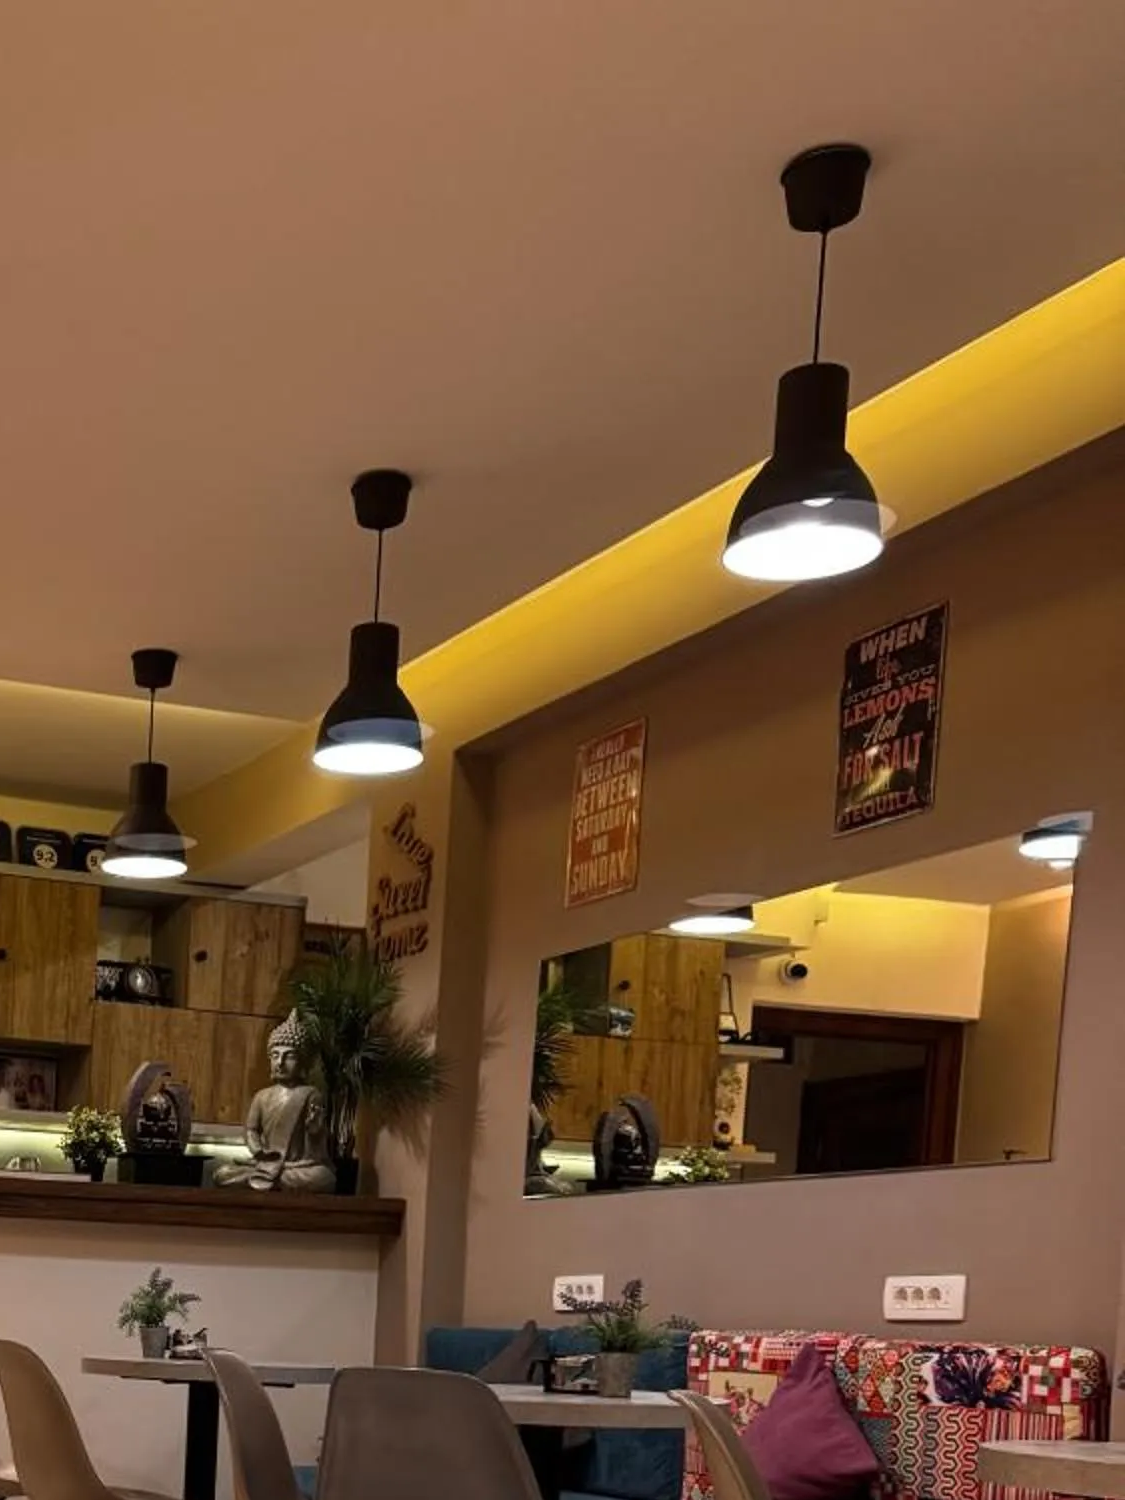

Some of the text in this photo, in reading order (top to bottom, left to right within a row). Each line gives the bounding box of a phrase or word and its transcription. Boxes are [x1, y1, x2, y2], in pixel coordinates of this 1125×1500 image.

[859, 616, 929, 664] WHEN
[898, 663, 936, 682] YOU
[842, 675, 937, 729] LEMONS
[842, 730, 925, 790] FOR SALT
[574, 769, 641, 820] BETWEEN
[840, 785, 919, 828] TEQUILA
[574, 802, 630, 844] SATURDAY
[570, 849, 630, 895] SUNDAY
